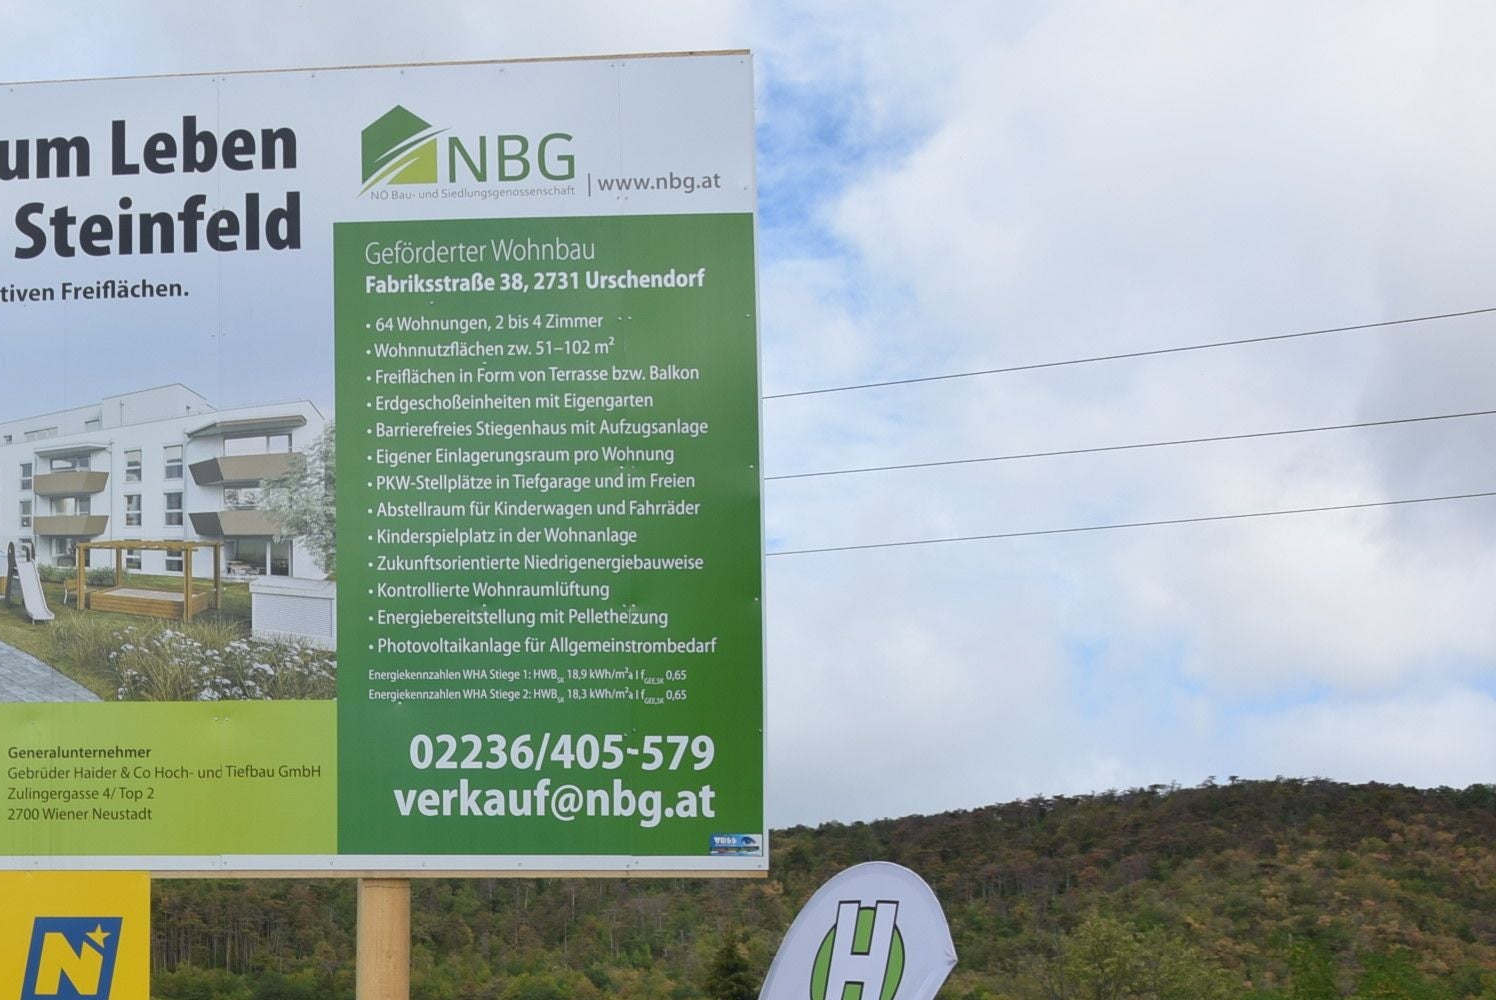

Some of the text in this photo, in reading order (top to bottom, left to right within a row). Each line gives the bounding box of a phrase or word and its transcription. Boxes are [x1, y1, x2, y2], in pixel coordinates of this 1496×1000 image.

[111, 116, 297, 175] Leben
[449, 133, 575, 183] NBG
[392, 189, 416, 200] Bau-
[419, 188, 438, 199] und
[441, 185, 575, 200] Siedlungsgenossenschaft
[598, 172, 720, 193] www.nbg.at
[14, 191, 301, 261] Steinfeld
[365, 237, 594, 265] Geförderter Wohnbau
[61, 280, 188, 302] Freiflächen.
[366, 268, 705, 294] Fabriksstraße 38, 2731 Urschendorf
[376, 314, 603, 334] 64 Wohnungen, 2 bis 4 Zimmer
[375, 342, 503, 358] Wohnnutzflächen
[508, 344, 532, 356] zw.
[595, 337, 614, 354] m²
[376, 365, 699, 384] Freiflächen in Form von Terrasse bzw. Balkon
[376, 393, 653, 413] Erdgeschoßeinheiten mit Eigengarten
[376, 419, 708, 439] Barrierefreies Stiegenhaus mit Aufzugsanlage
[377, 446, 674, 467] Eigener Einlagerungsraum pro Wohnung
[377, 474, 695, 493] PKW-Stellplätze in Tiefgarage und im Freien
[377, 500, 700, 518] Abstellraum für Kinderwagen und Fahrräder
[377, 528, 636, 547] Kinderspielplatz in der Wohnanlage
[377, 554, 703, 573] Zukunftsorientierte Niedrigenergiebauweise
[378, 582, 610, 600] Kontrollierte Wohnraumlüftung
[378, 608, 668, 628] Energiebereitstellung mit Pelletheizung
[378, 636, 717, 656] Photovoltaikanlage für Allgemeinstrombedarf
[369, 670, 461, 683] Energiekennzahlen
[463, 670, 486, 680] WHA
[490, 669, 520, 682] Stiege
[369, 689, 461, 702] Energiekennzahlen
[463, 690, 486, 699] WHA
[490, 689, 520, 701] Stiege
[8, 746, 151, 759] Generalunternehmer
[409, 733, 714, 771] 02236/405-579
[8, 767, 70, 779] Gebrüder
[75, 767, 116, 779] Haider
[121, 768, 129, 778] &
[134, 768, 151, 779] Co
[155, 767, 194, 778] Hoch-
[226, 765, 274, 778] Tiefbau
[279, 765, 320, 777] GmbH
[8, 788, 99, 803] Zulingergasse
[120, 788, 143, 801] Top
[147, 787, 154, 799] 2
[394, 778, 715, 828] verkauf@nbg.at
[8, 808, 152, 820] 2700 Wiener Neustadt
